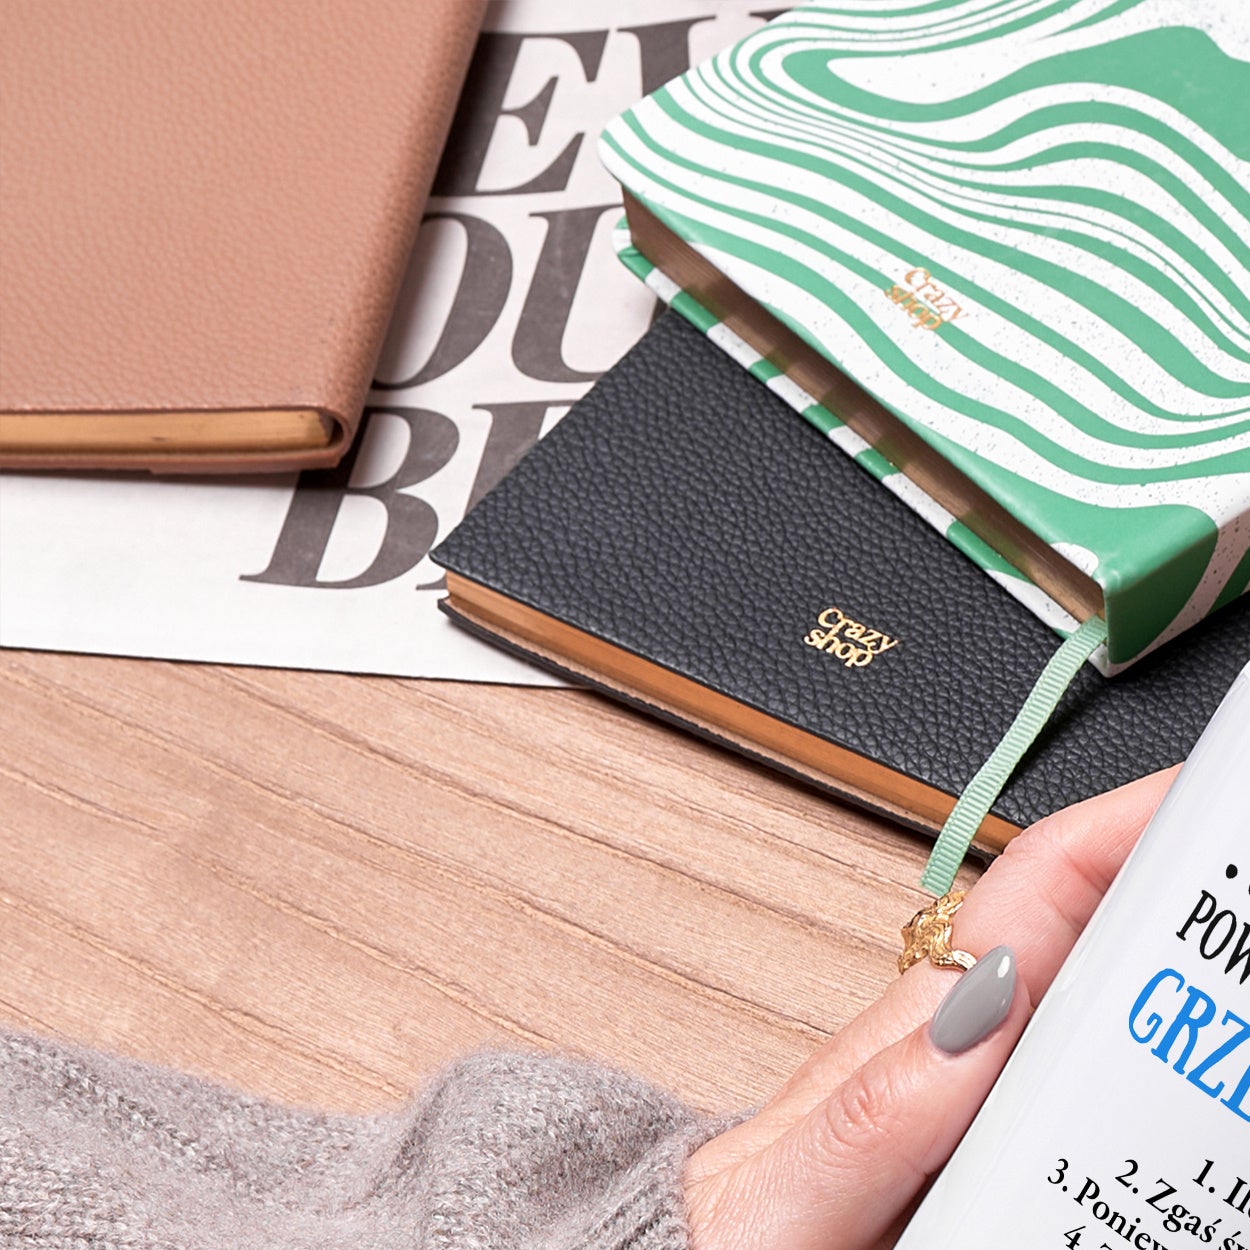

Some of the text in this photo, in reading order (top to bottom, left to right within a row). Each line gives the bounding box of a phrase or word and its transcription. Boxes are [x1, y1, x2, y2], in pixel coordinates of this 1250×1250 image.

[883, 284, 943, 330] shop
[803, 628, 874, 669] shop
[1048, 1159, 1069, 1193] 3.
[1193, 1160, 1215, 1193] 1.
[1115, 1160, 1139, 1195] 2.
[1146, 1178, 1223, 1243] Zgaś
